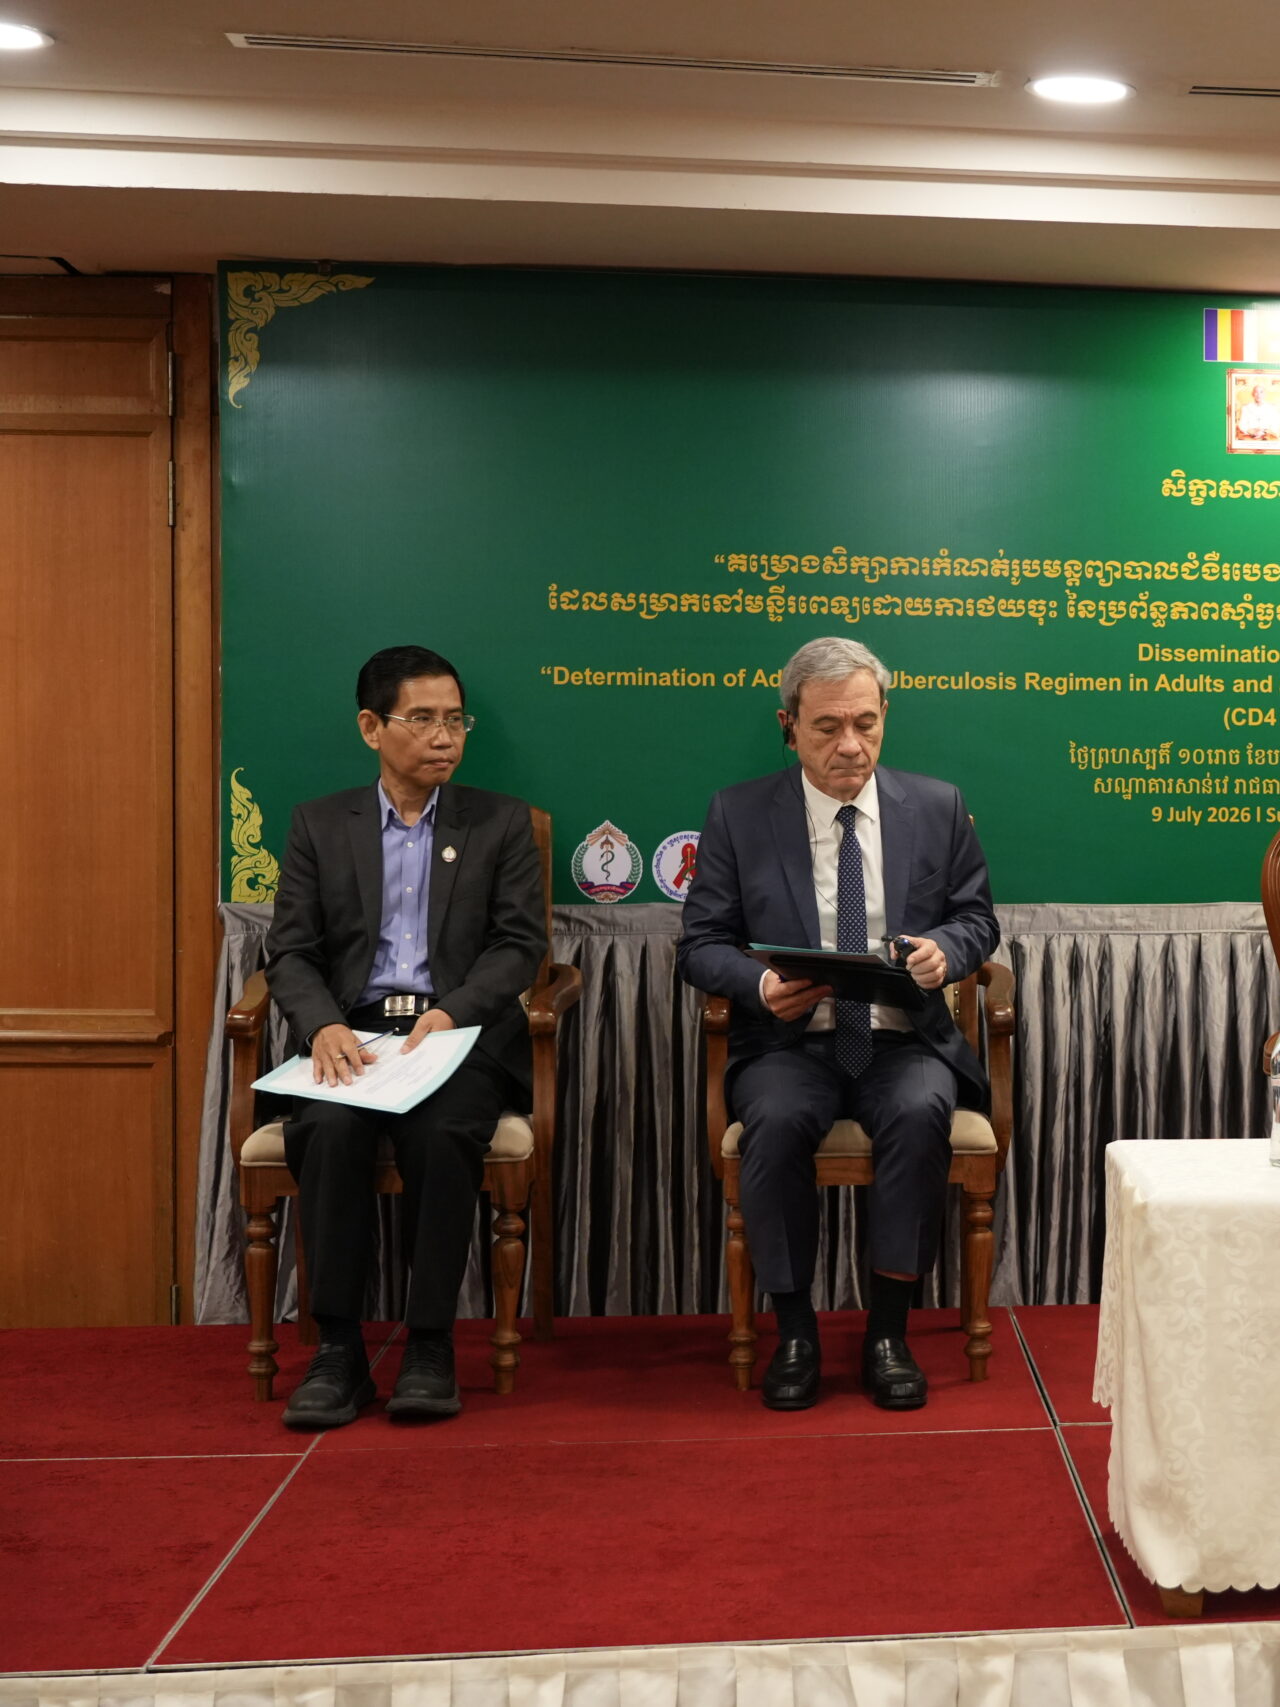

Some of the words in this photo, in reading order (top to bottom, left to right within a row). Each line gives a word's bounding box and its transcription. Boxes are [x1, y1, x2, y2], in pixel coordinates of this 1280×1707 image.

[541, 666, 716, 687] “Determination
[723, 668, 747, 687] of
[1024, 672, 1122, 696] Regimen
[1129, 674, 1149, 692] in
[1154, 673, 1225, 693] Adults
[1232, 675, 1273, 693] and
[1223, 707, 1277, 729] (CD4
[1151, 806, 1163, 823] 9
[1166, 806, 1203, 826] July
[1207, 806, 1252, 823] 2026
